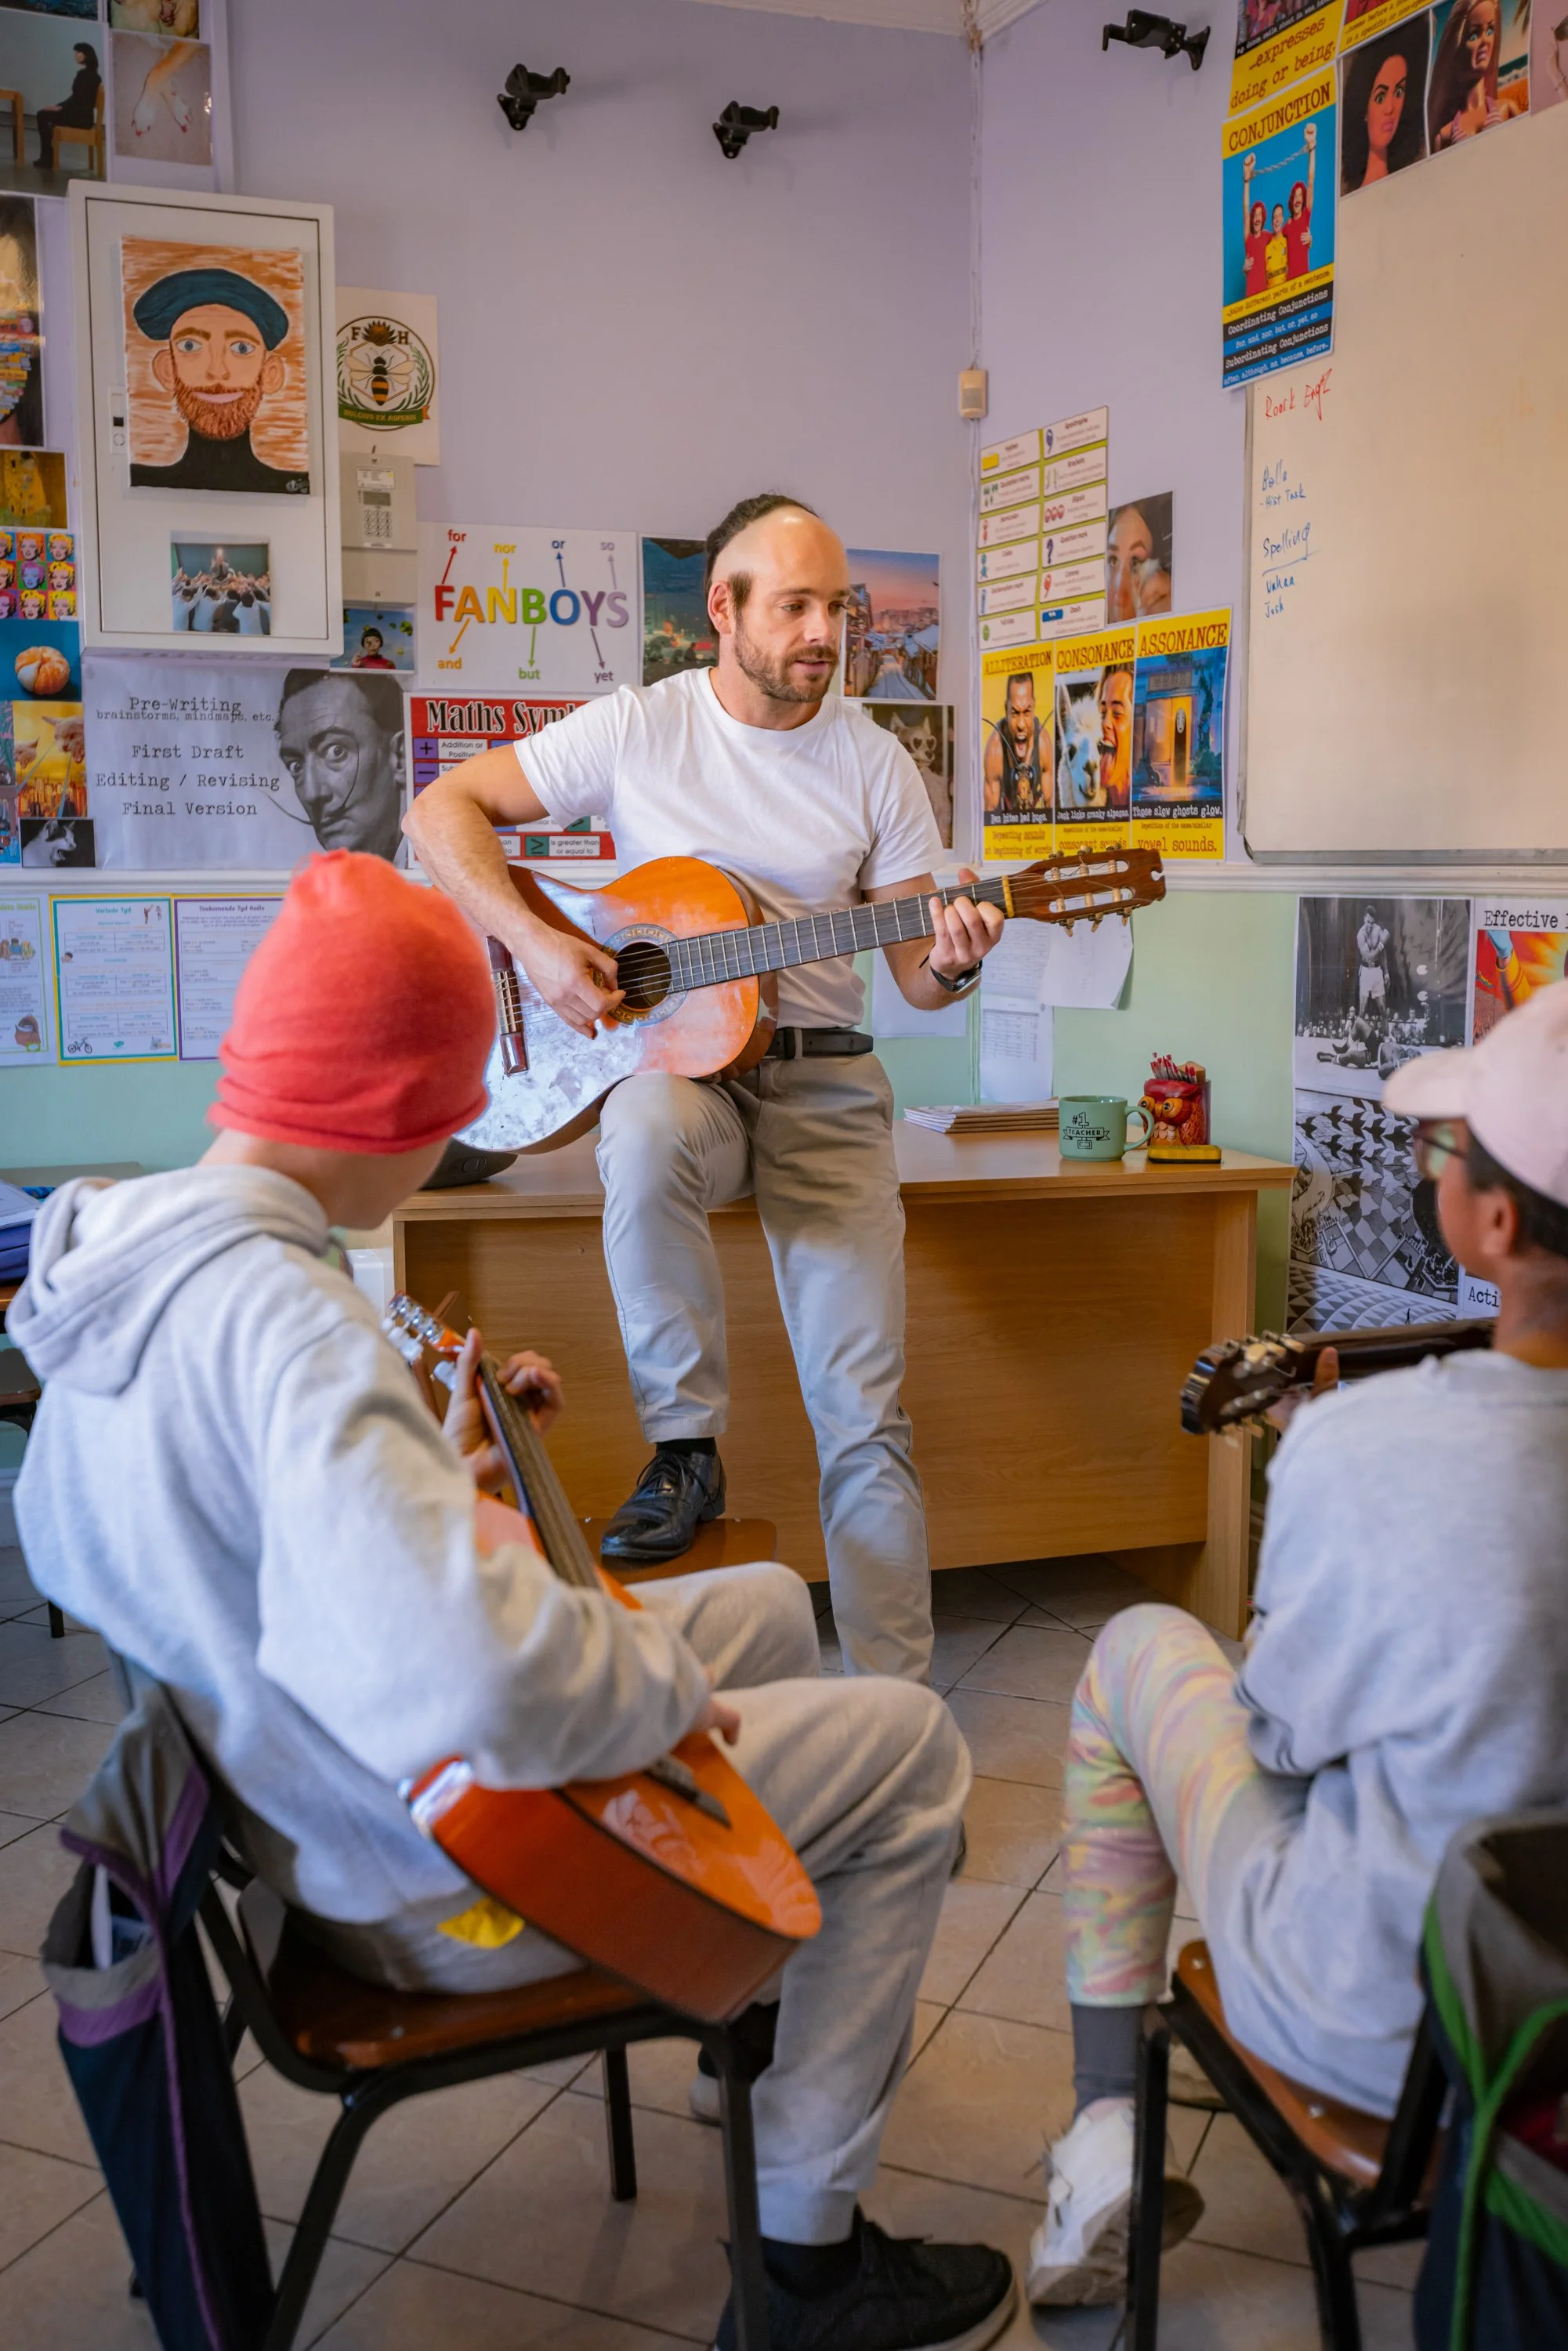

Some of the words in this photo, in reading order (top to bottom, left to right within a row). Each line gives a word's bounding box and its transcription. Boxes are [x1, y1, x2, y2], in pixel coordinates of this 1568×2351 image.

[1231, 78, 1268, 109] doing
[1272, 66, 1289, 85] or
[1294, 41, 1337, 73] being.
[1228, 82, 1331, 152] CONJUNCTION
[1228, 310, 1276, 335] Coordinating
[1278, 289, 1328, 316] Conjunctions
[351, 326, 360, 340] F
[398, 331, 409, 345] H
[1226, 344, 1278, 369] Subordinating
[1279, 323, 1329, 348] Conjunctions
[447, 529, 467, 542] for
[493, 543, 517, 553] nor
[552, 539, 567, 549] or
[600, 541, 615, 552] so
[434, 585, 630, 629] FANBOYS
[1139, 623, 1227, 656] ASSONANCE
[1056, 638, 1134, 668] CONSONANCE
[437, 657, 462, 670] and
[984, 650, 1052, 675] ALLITERATION
[518, 668, 541, 680] but
[594, 671, 614, 683] yet
[129, 696, 242, 717] Pre-Writing
[96, 709, 179, 721] brainstorms,
[185, 709, 248, 723] mindmaps,
[252, 712, 274, 722] etc.
[426, 700, 505, 733] Maths
[131, 744, 182, 759] First
[191, 744, 244, 759] Draft
[96, 773, 170, 792] Editing
[179, 773, 187, 787] /
[196, 773, 281, 792] Revising
[122, 801, 176, 815] Final
[185, 801, 258, 815] Version
[1132, 806, 1153, 817] Those
[1153, 806, 1171, 817] slow
[1172, 805, 1199, 819] ghosts
[1200, 804, 1222, 818] glow.
[990, 813, 1001, 824] Ben
[1002, 813, 1019, 824] bites
[1023, 828, 1046, 840] sounds
[994, 845, 1023, 857] beginning
[1026, 845, 1033, 854] of
[1137, 837, 1168, 852] vowel
[1171, 836, 1217, 853] sounds.
[1484, 910, 1559, 929] Effective
[1072, 1111, 1090, 1126] #1
[1468, 1286, 1501, 1308] Acti
